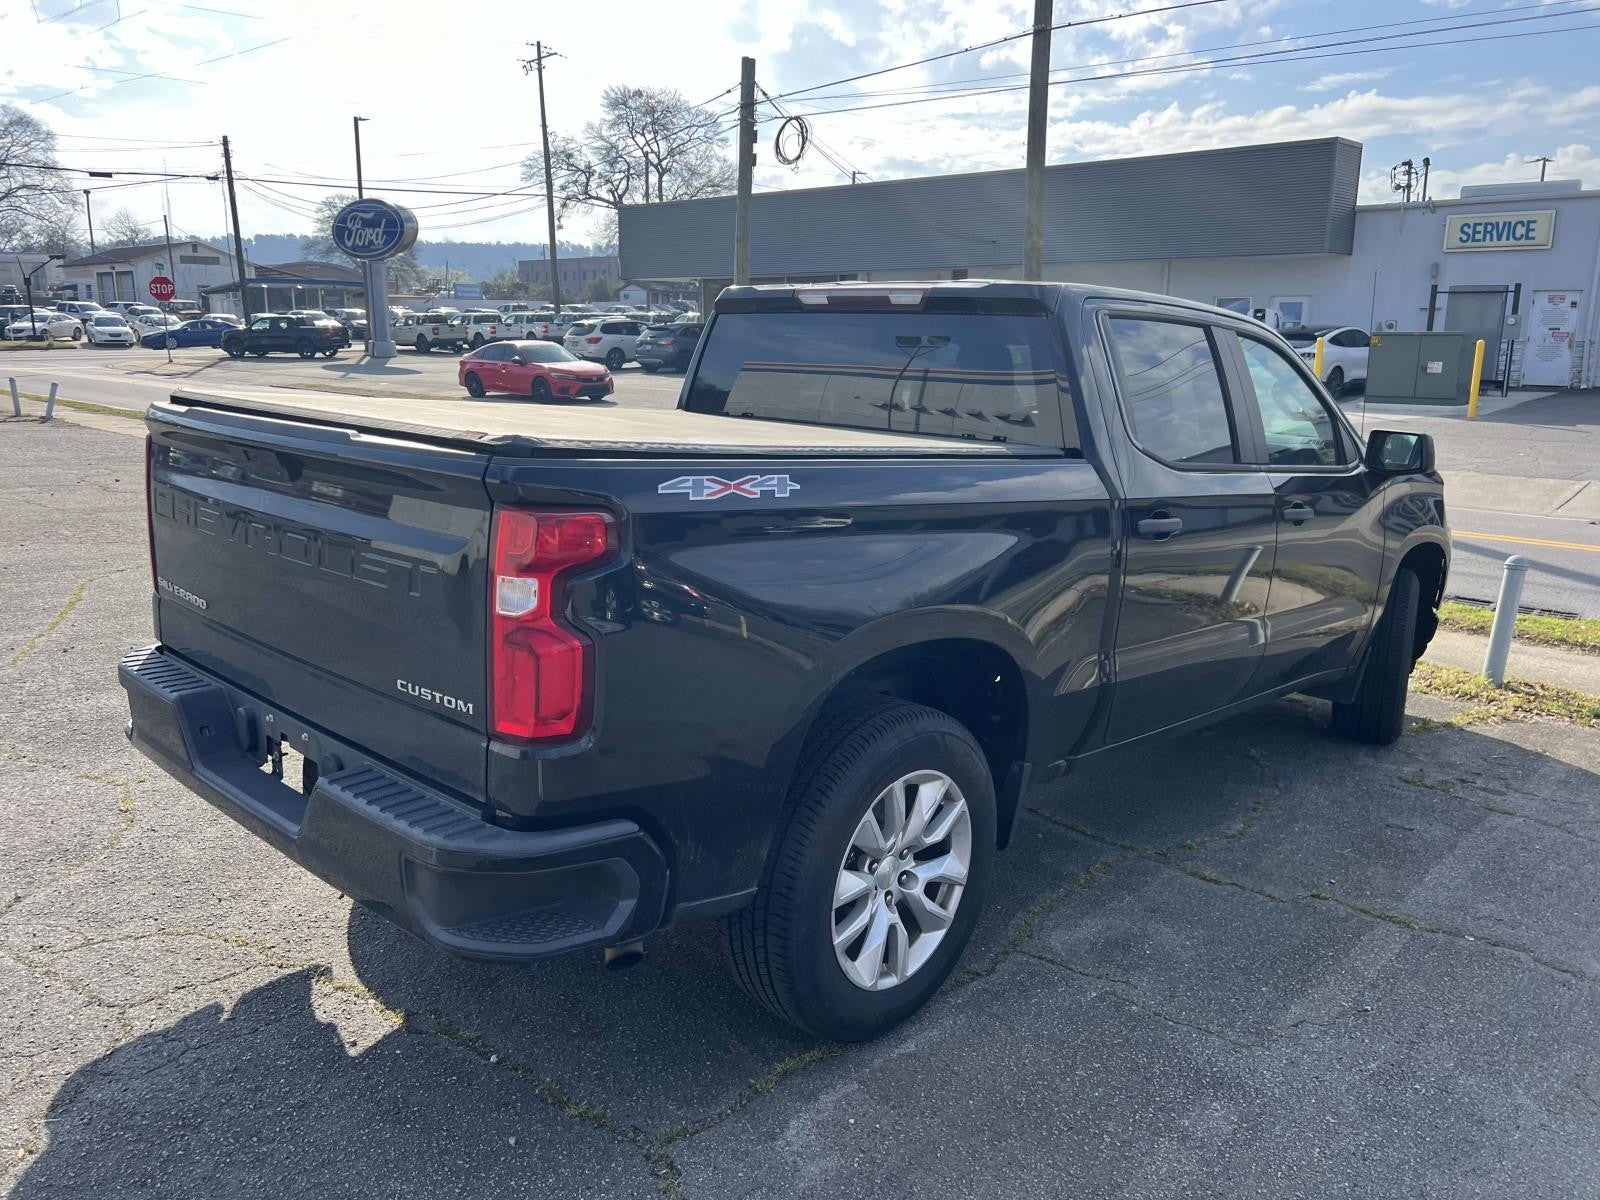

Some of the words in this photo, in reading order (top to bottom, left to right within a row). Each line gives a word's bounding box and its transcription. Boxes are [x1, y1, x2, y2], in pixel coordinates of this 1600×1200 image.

[345, 212, 386, 247] Ford
[1459, 220, 1537, 243] SERVICE
[150, 284, 174, 294] STOP
[154, 487, 438, 597] CHEVROLET
[157, 576, 207, 610] SILVERADO
[396, 679, 474, 715] CUSTOM
